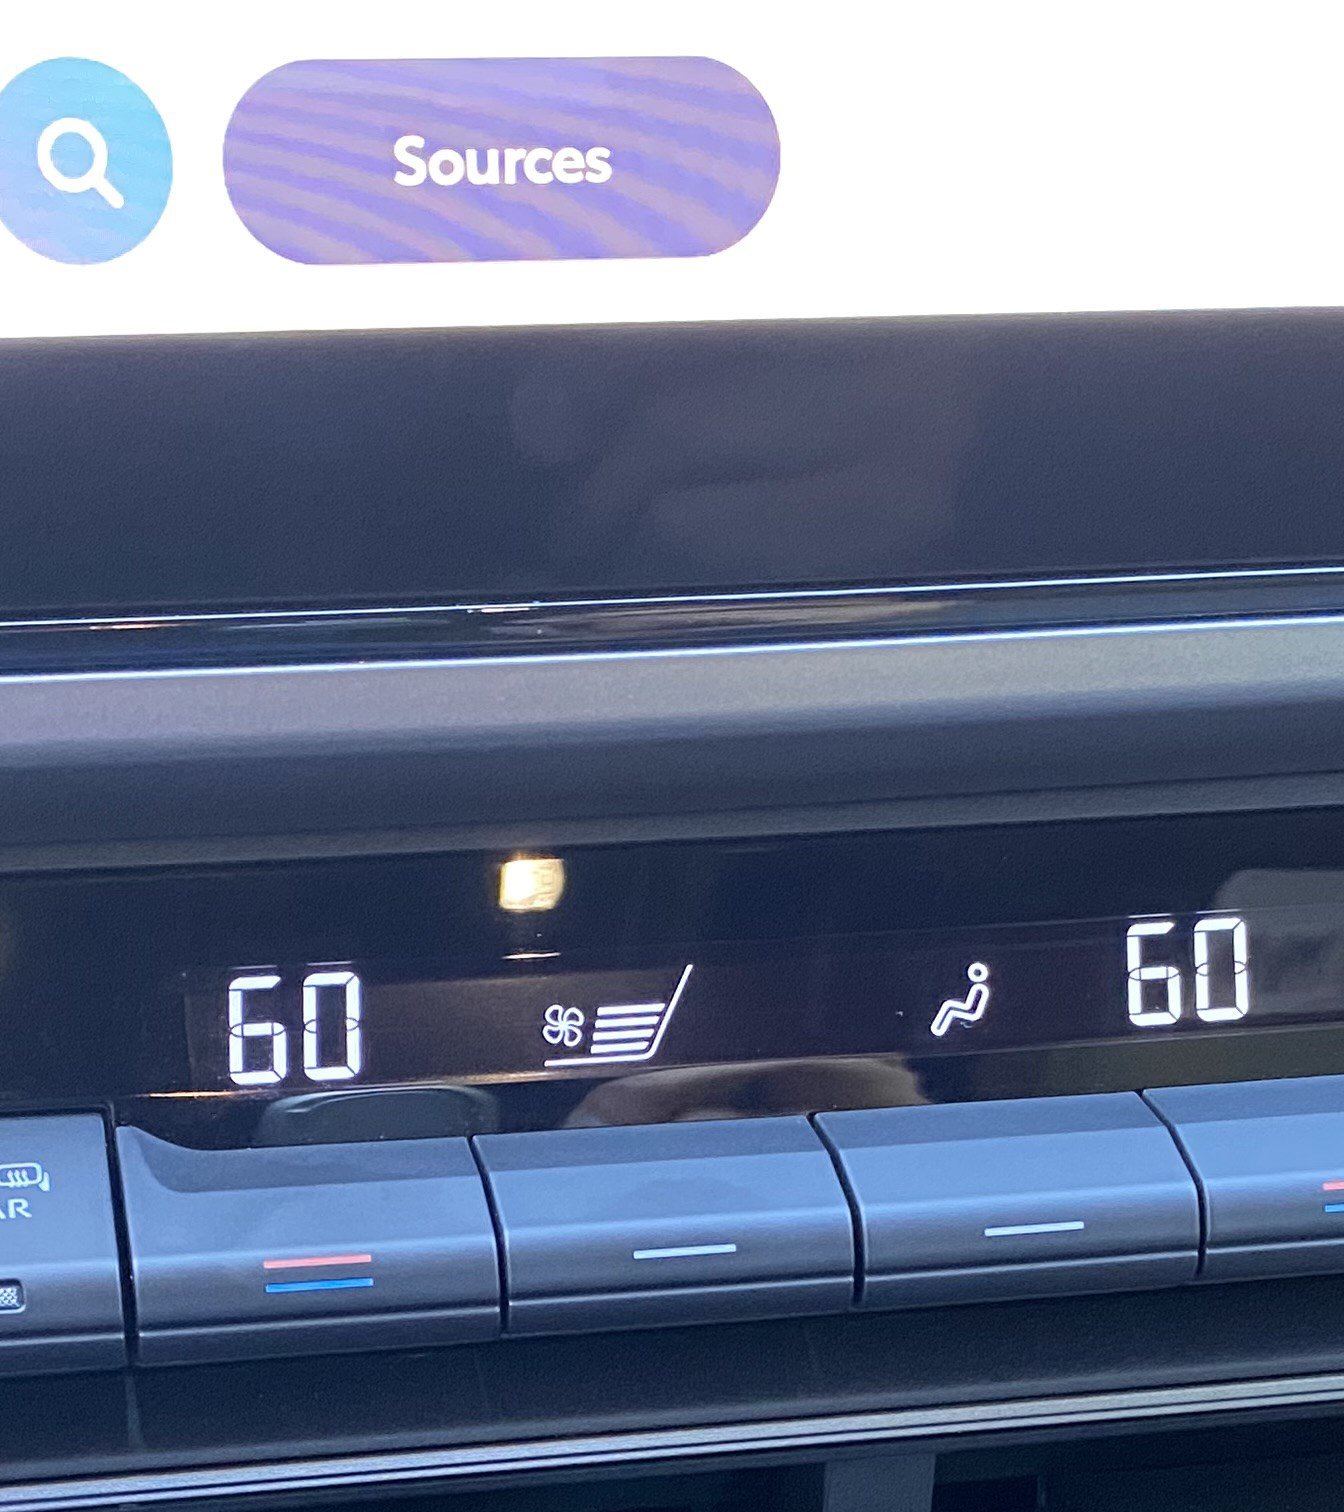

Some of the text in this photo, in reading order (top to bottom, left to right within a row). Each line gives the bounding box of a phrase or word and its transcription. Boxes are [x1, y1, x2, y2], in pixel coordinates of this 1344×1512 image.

[393, 134, 613, 187] Sources
[1126, 917, 1251, 1027] 60
[227, 970, 362, 1086] 60
